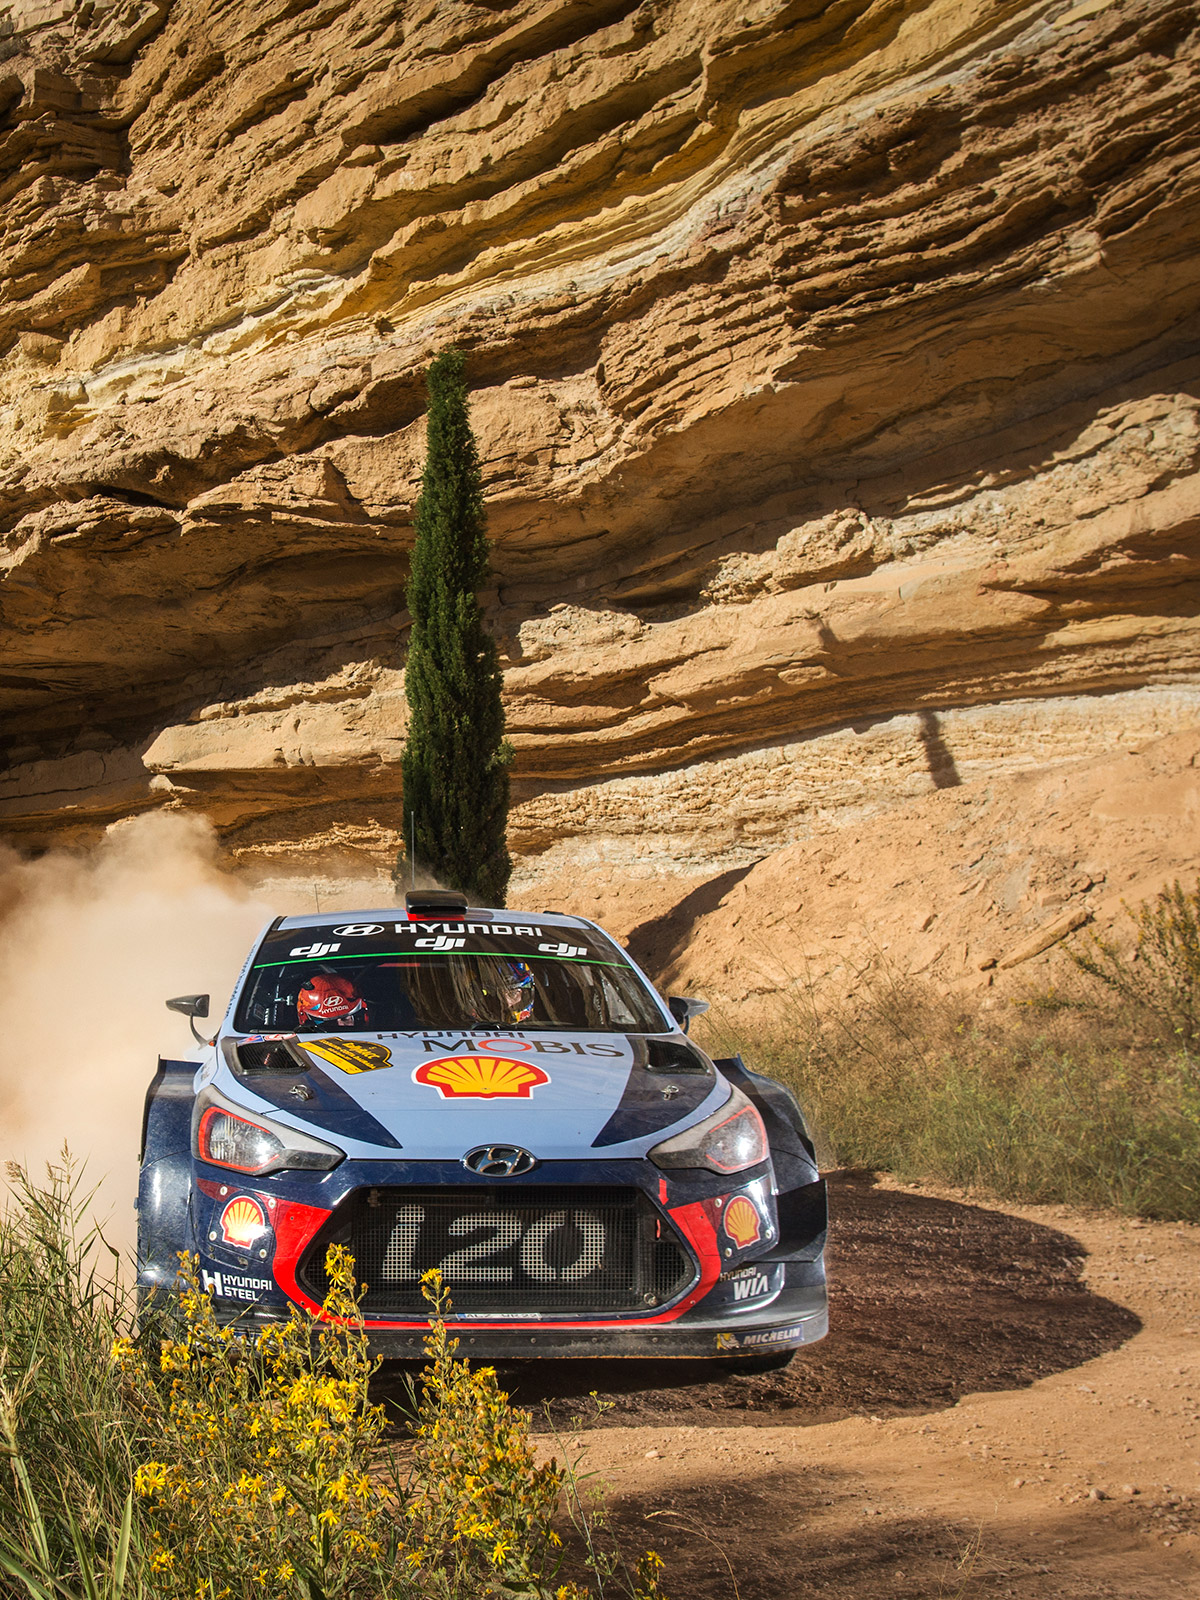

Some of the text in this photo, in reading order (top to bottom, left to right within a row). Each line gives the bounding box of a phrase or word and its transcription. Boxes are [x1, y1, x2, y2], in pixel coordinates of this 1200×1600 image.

[395, 923, 543, 937] HYUNDAI
[321, 1005, 349, 1014] HYUNDAI
[376, 1031, 526, 1040] HYUNDAI
[421, 1039, 625, 1057] MOBIS
[721, 1266, 757, 1281] HYUNDAI
[222, 1274, 272, 1291] HYUNDAI
[224, 1286, 260, 1301] STEEL
[743, 1327, 801, 1345] MICHELIN
